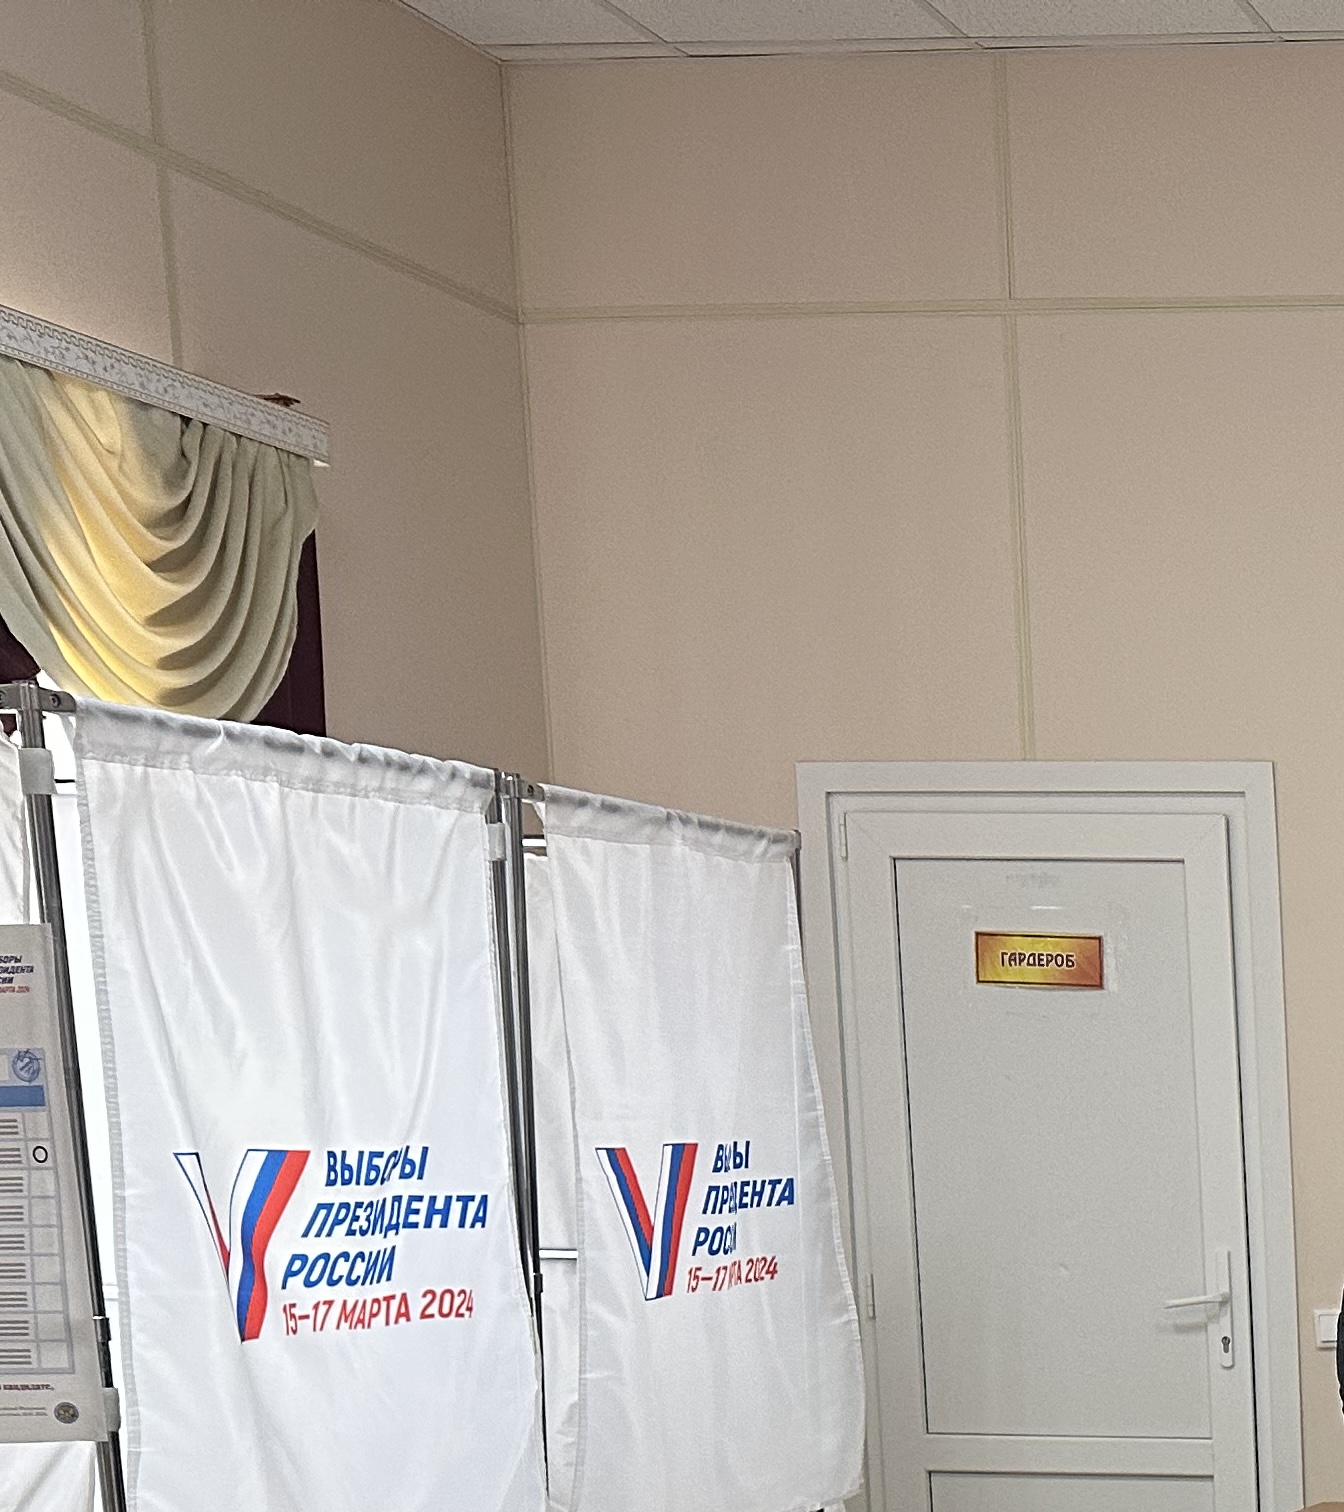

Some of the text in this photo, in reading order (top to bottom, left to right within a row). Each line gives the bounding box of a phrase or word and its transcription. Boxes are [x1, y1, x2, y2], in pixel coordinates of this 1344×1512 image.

[1001, 951, 1075, 968] ГАРДЕРОБ
[300, 1194, 489, 1239] ПРЕЗИДЕНТА
[281, 1245, 397, 1290] РОССИИ
[336, 1292, 411, 1330] МАРТА
[419, 1288, 474, 1320] 2024
